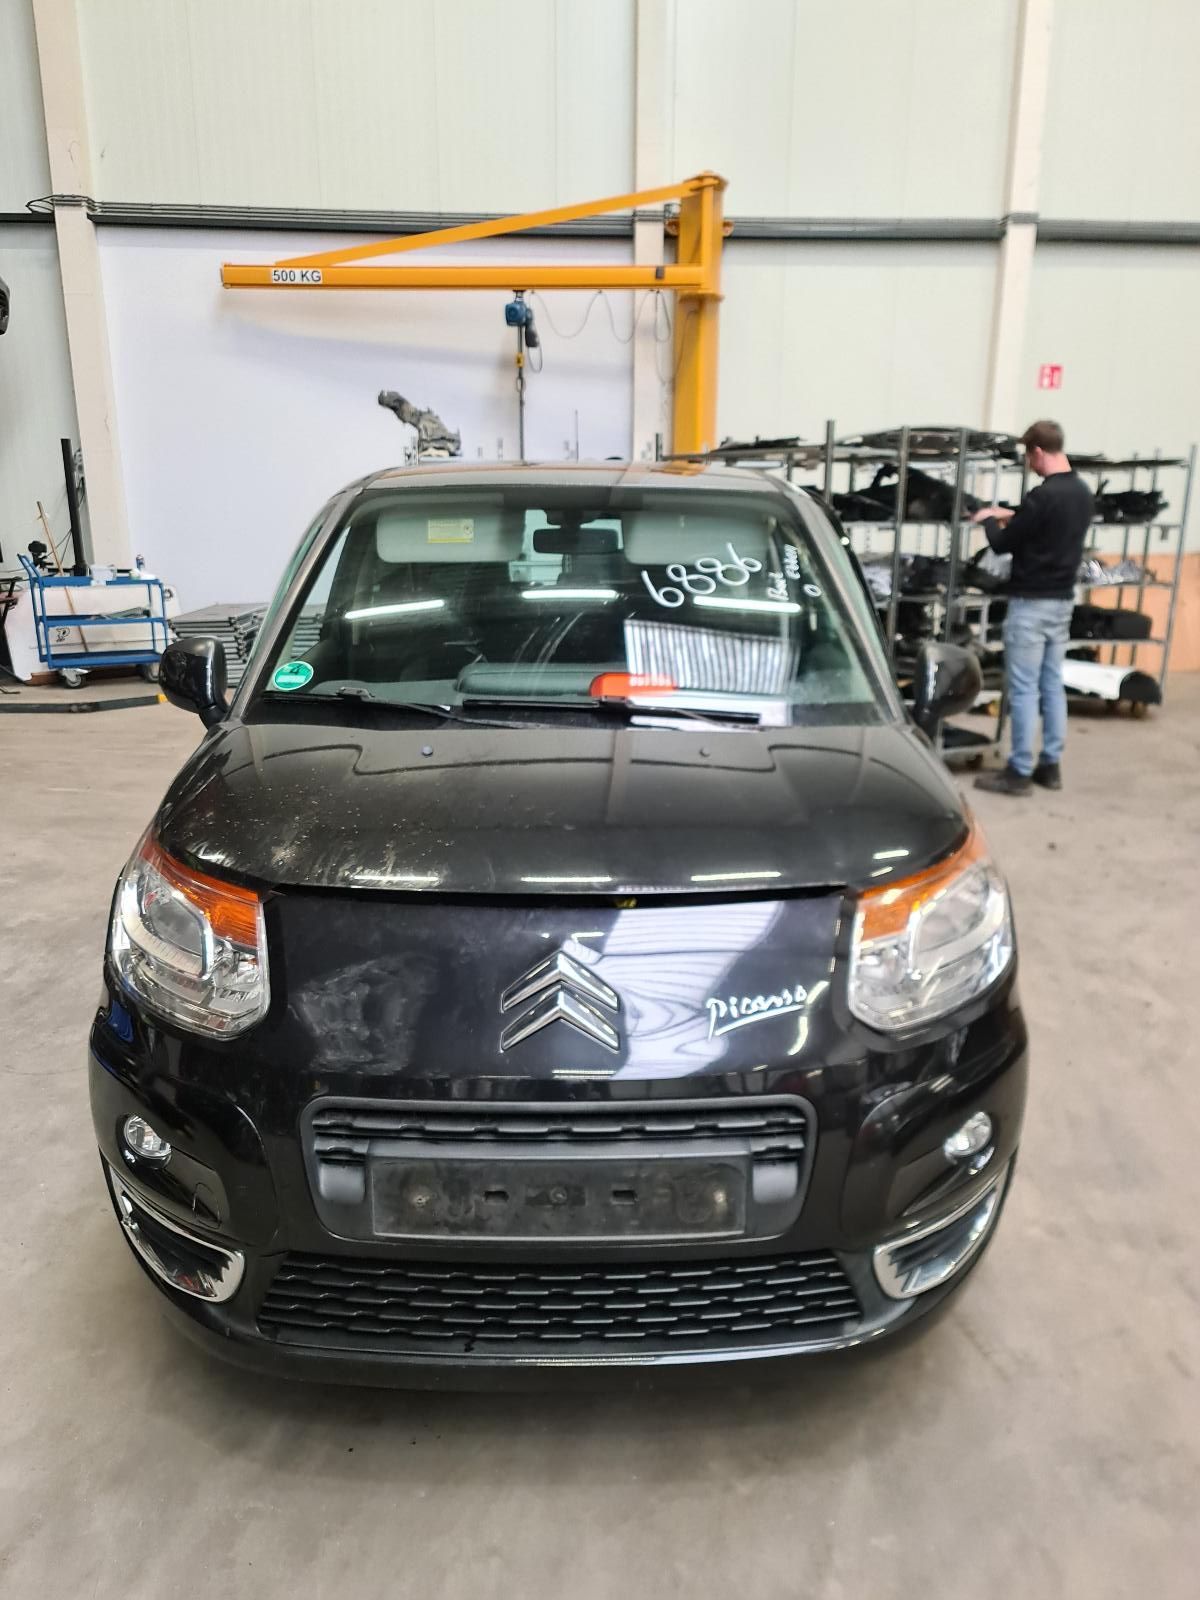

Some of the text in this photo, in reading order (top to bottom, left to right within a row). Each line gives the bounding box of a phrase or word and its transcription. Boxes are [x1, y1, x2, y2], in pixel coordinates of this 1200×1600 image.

[273, 269, 322, 282] 500 KG
[641, 542, 762, 608] 6886
